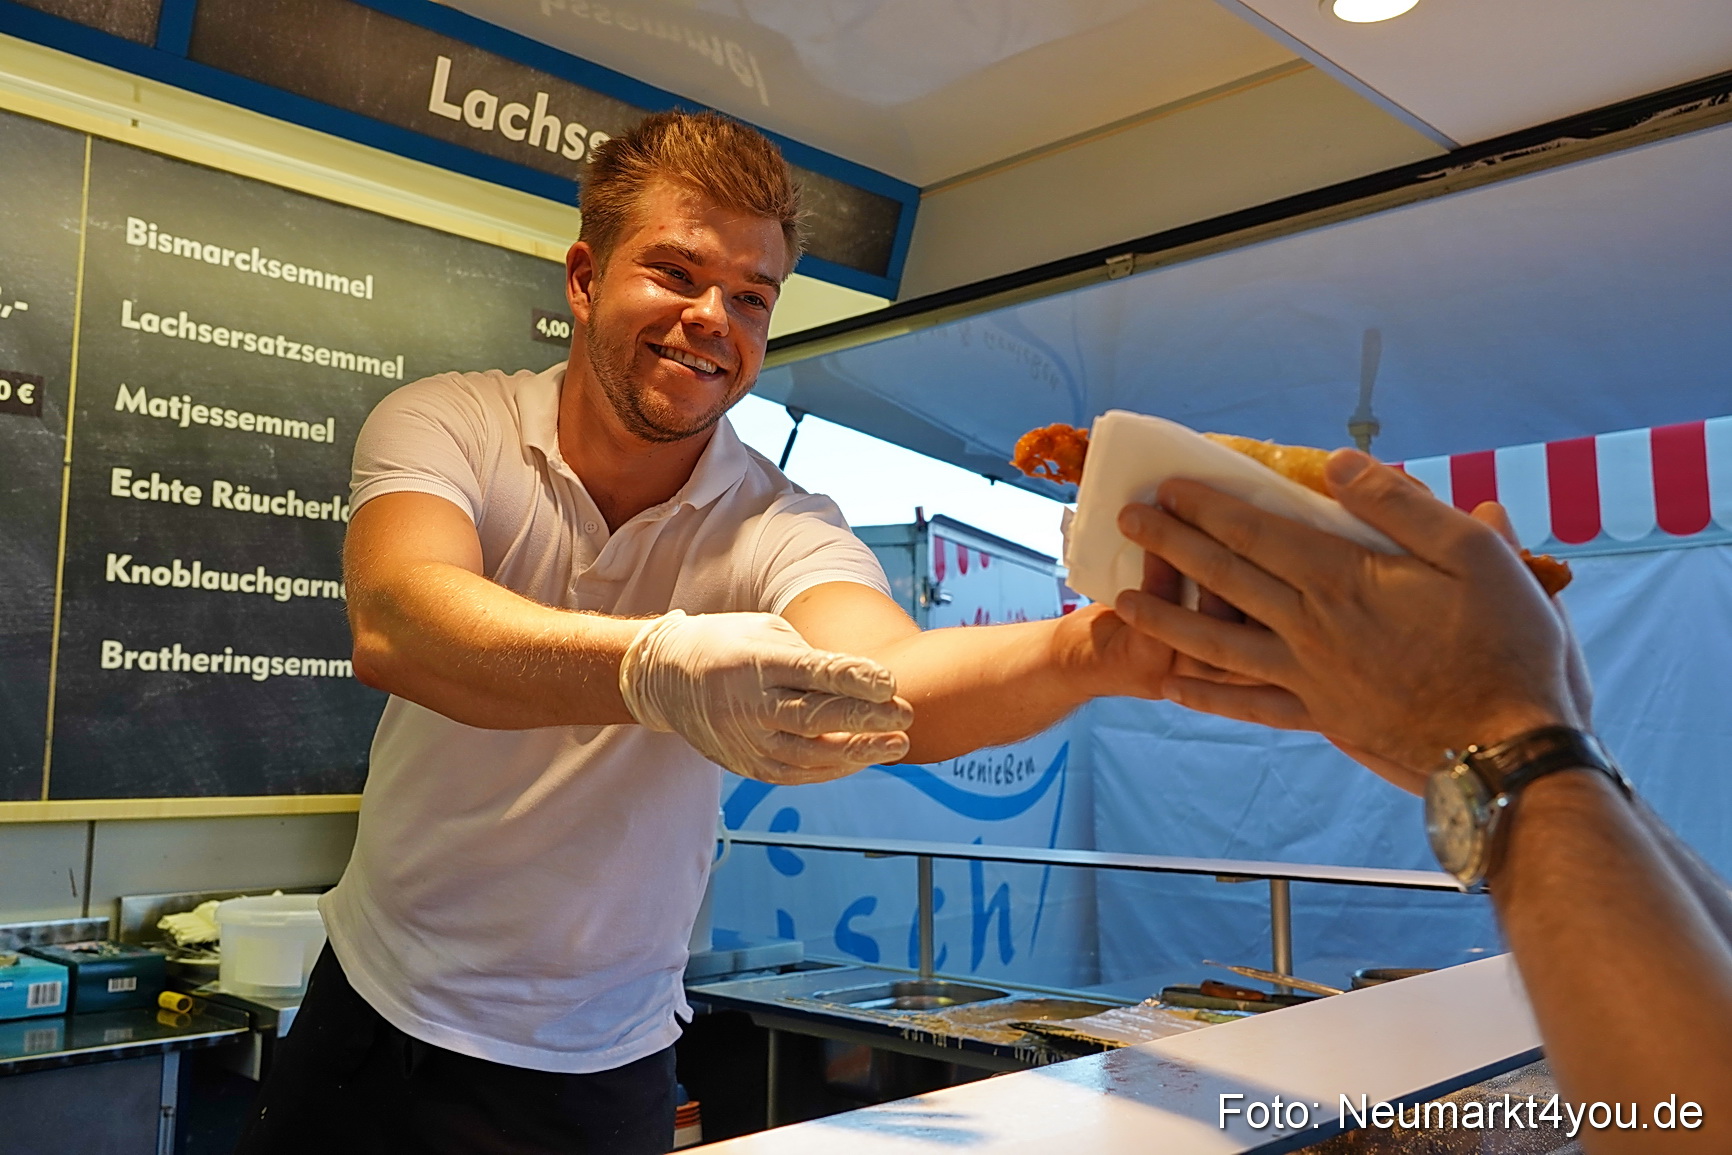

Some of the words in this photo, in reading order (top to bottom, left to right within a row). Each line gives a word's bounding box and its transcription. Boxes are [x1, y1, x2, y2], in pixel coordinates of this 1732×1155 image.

[126, 216, 374, 299] Bismarcksemmel
[121, 299, 404, 380] Lachsersatzsemmel
[536, 317, 570, 338] 4,00
[17, 383, 35, 405] €
[115, 383, 335, 443] Matjessemmel
[111, 467, 202, 506] Echte
[101, 640, 354, 681] Bratheringsemm
